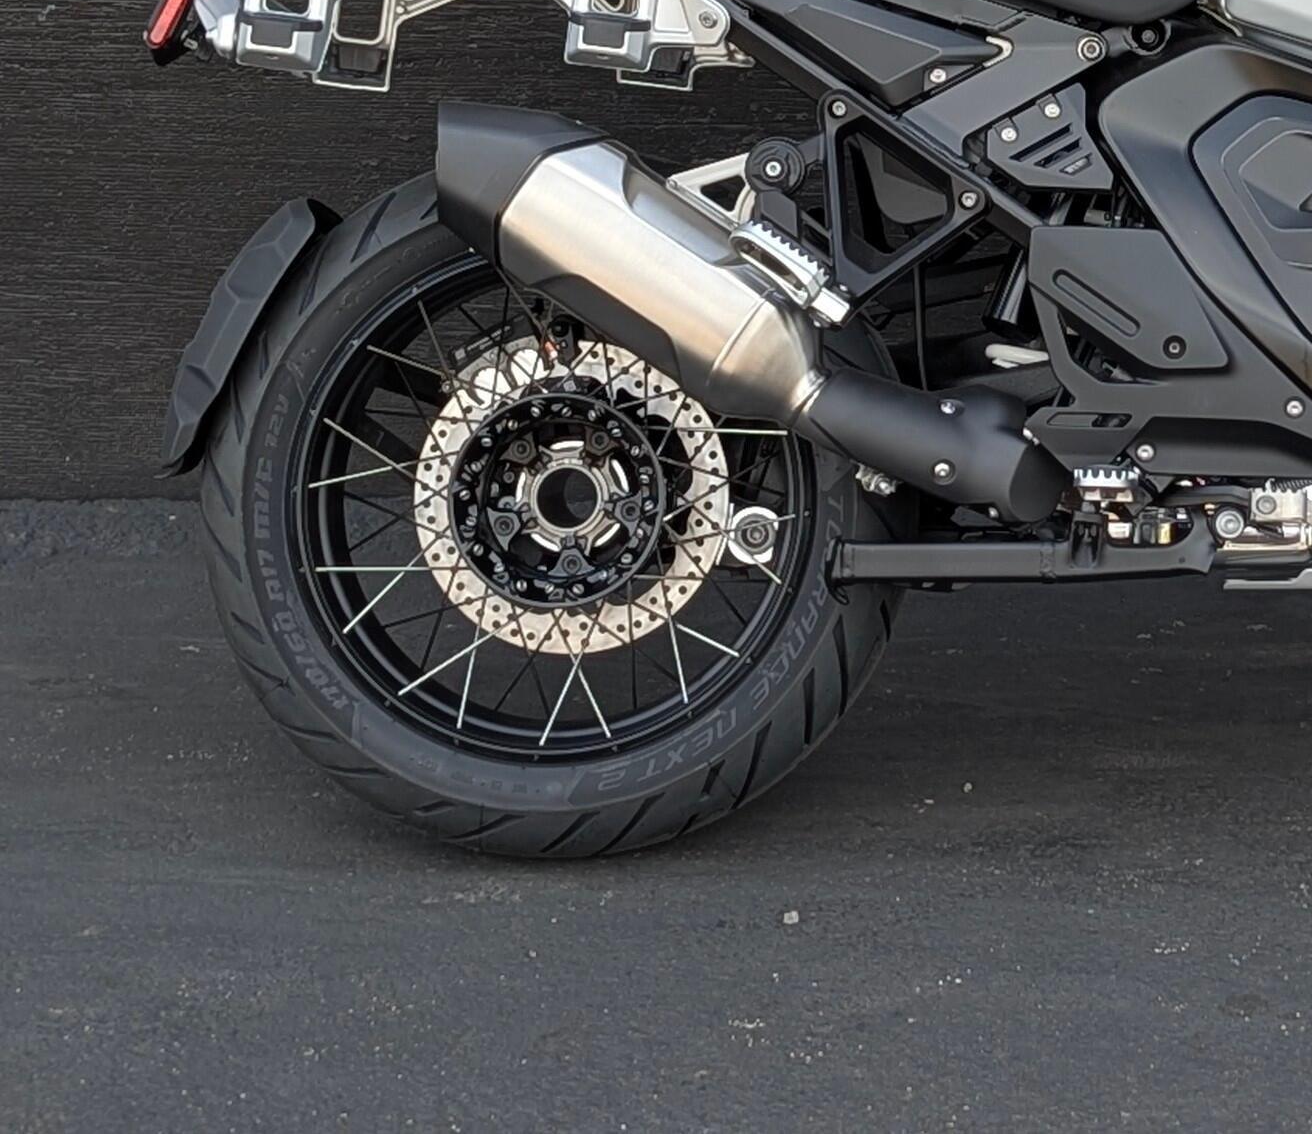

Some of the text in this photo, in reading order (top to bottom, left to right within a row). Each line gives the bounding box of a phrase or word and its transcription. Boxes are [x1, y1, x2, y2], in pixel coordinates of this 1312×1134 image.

[750, 495, 845, 710] TORANCE
[597, 770, 630, 792] 2
[637, 709, 738, 782] NEXT
